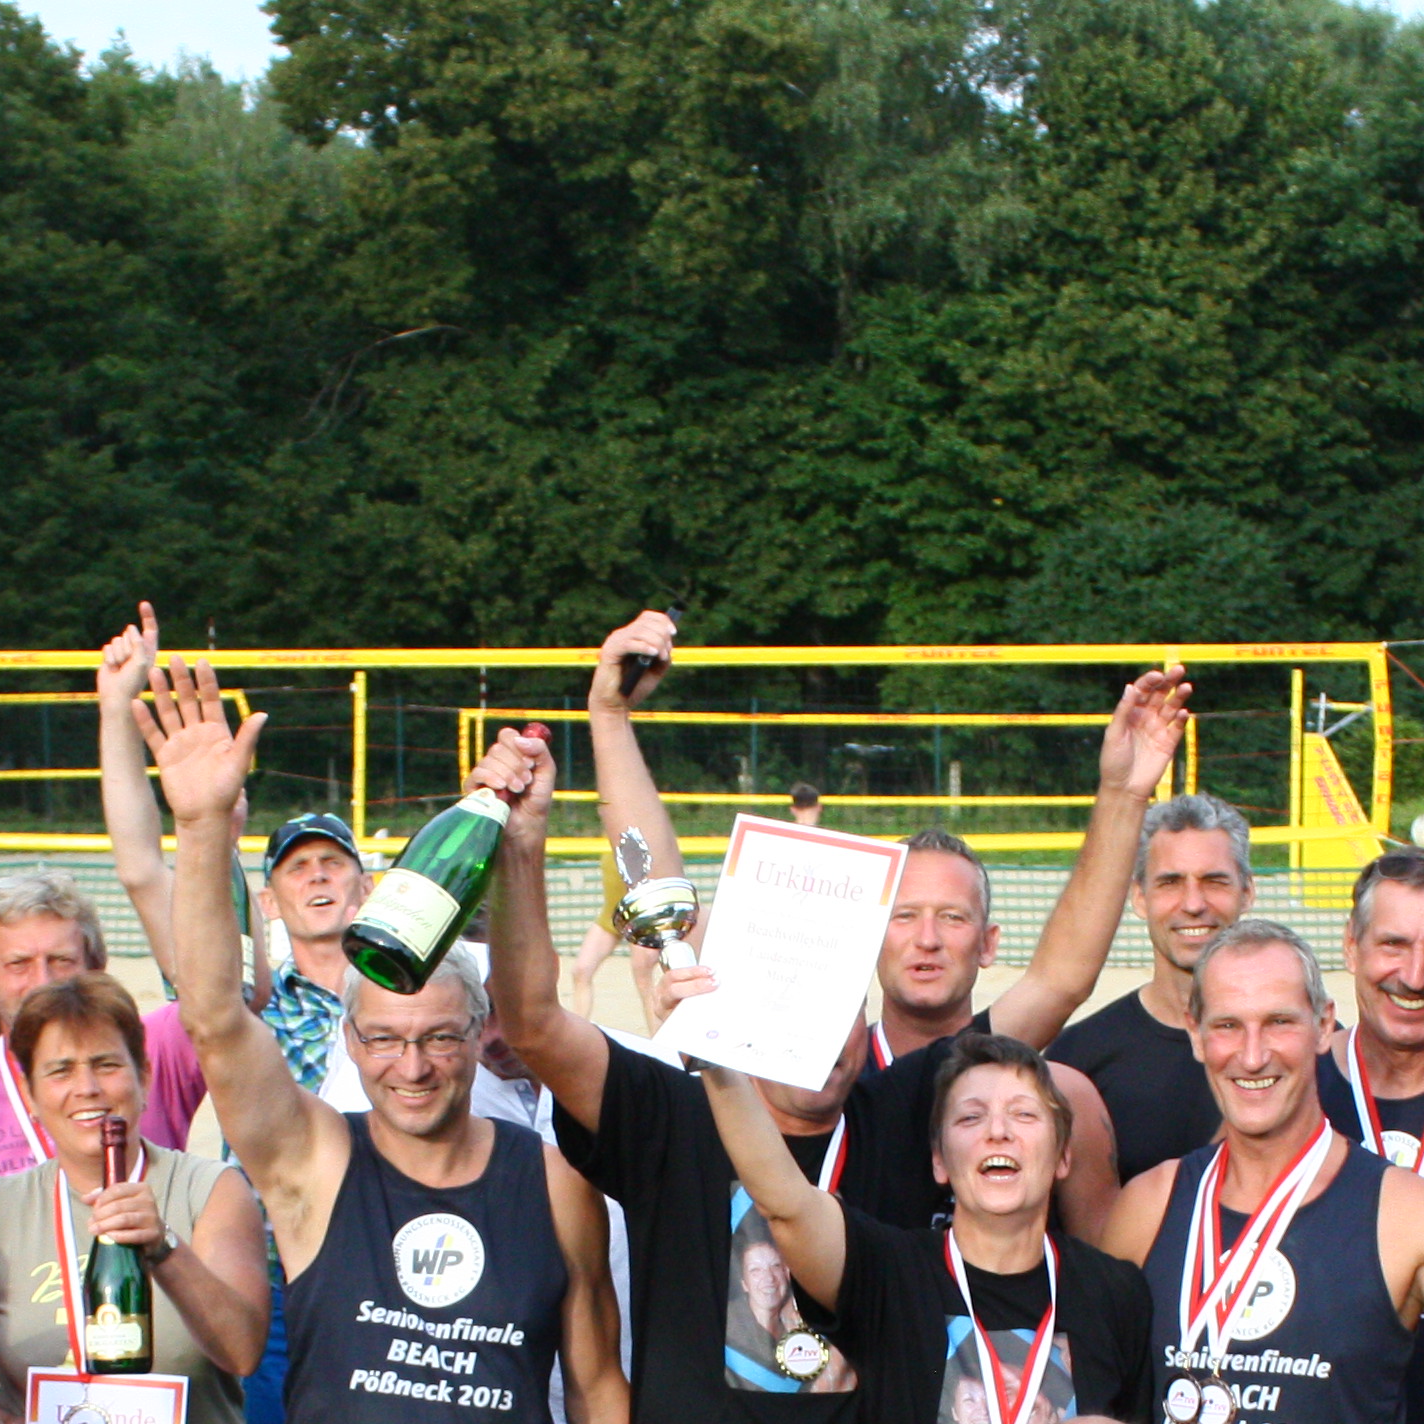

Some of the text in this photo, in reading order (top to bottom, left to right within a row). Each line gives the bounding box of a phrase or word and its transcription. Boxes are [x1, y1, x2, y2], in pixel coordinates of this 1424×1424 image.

[755, 860, 863, 902] Urkunde
[395, 1217, 480, 1274] WOHNUNGSGENOSSENSCHAFT
[412, 1249, 465, 1276] WP
[356, 1300, 526, 1346] Seniorenfinale
[386, 1338, 478, 1375] BEACH
[349, 1368, 514, 1411] Pößneck 2013
[1230, 1383, 1281, 1411] ACH
